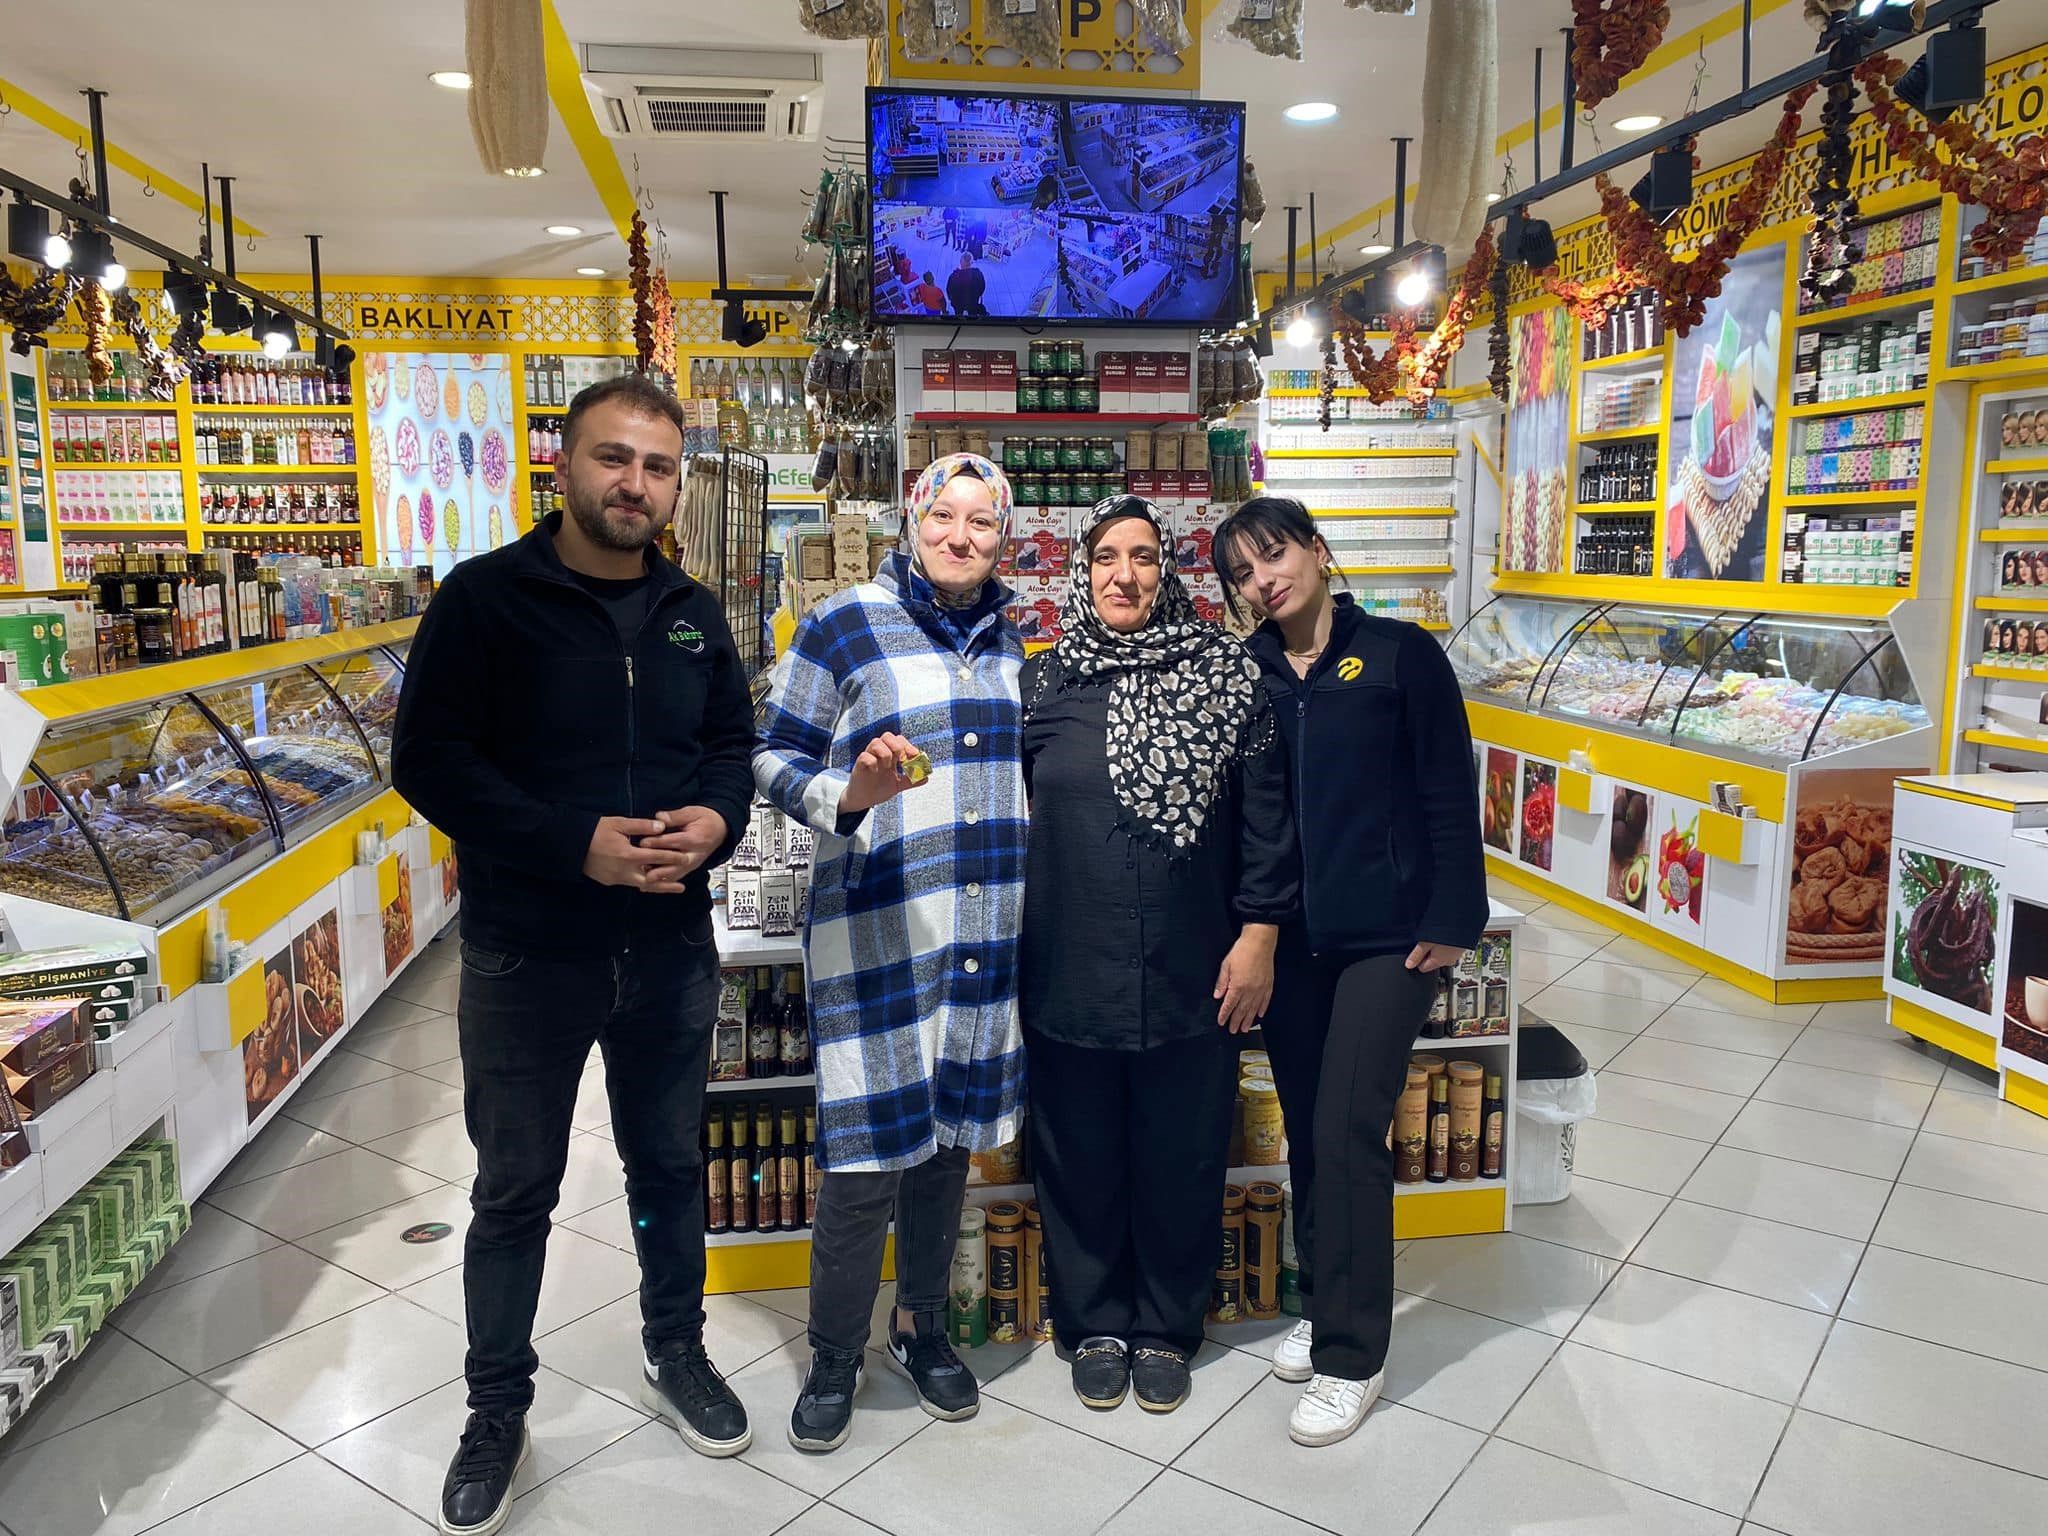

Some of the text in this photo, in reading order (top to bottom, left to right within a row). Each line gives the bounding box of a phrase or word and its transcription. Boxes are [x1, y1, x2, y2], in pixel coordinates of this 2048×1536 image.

[360, 304, 513, 330] BAKLİYAT
[733, 906, 755, 914] DAK
[767, 911, 789, 920] DAK
[39, 968, 107, 985] PİŞMANİYE
